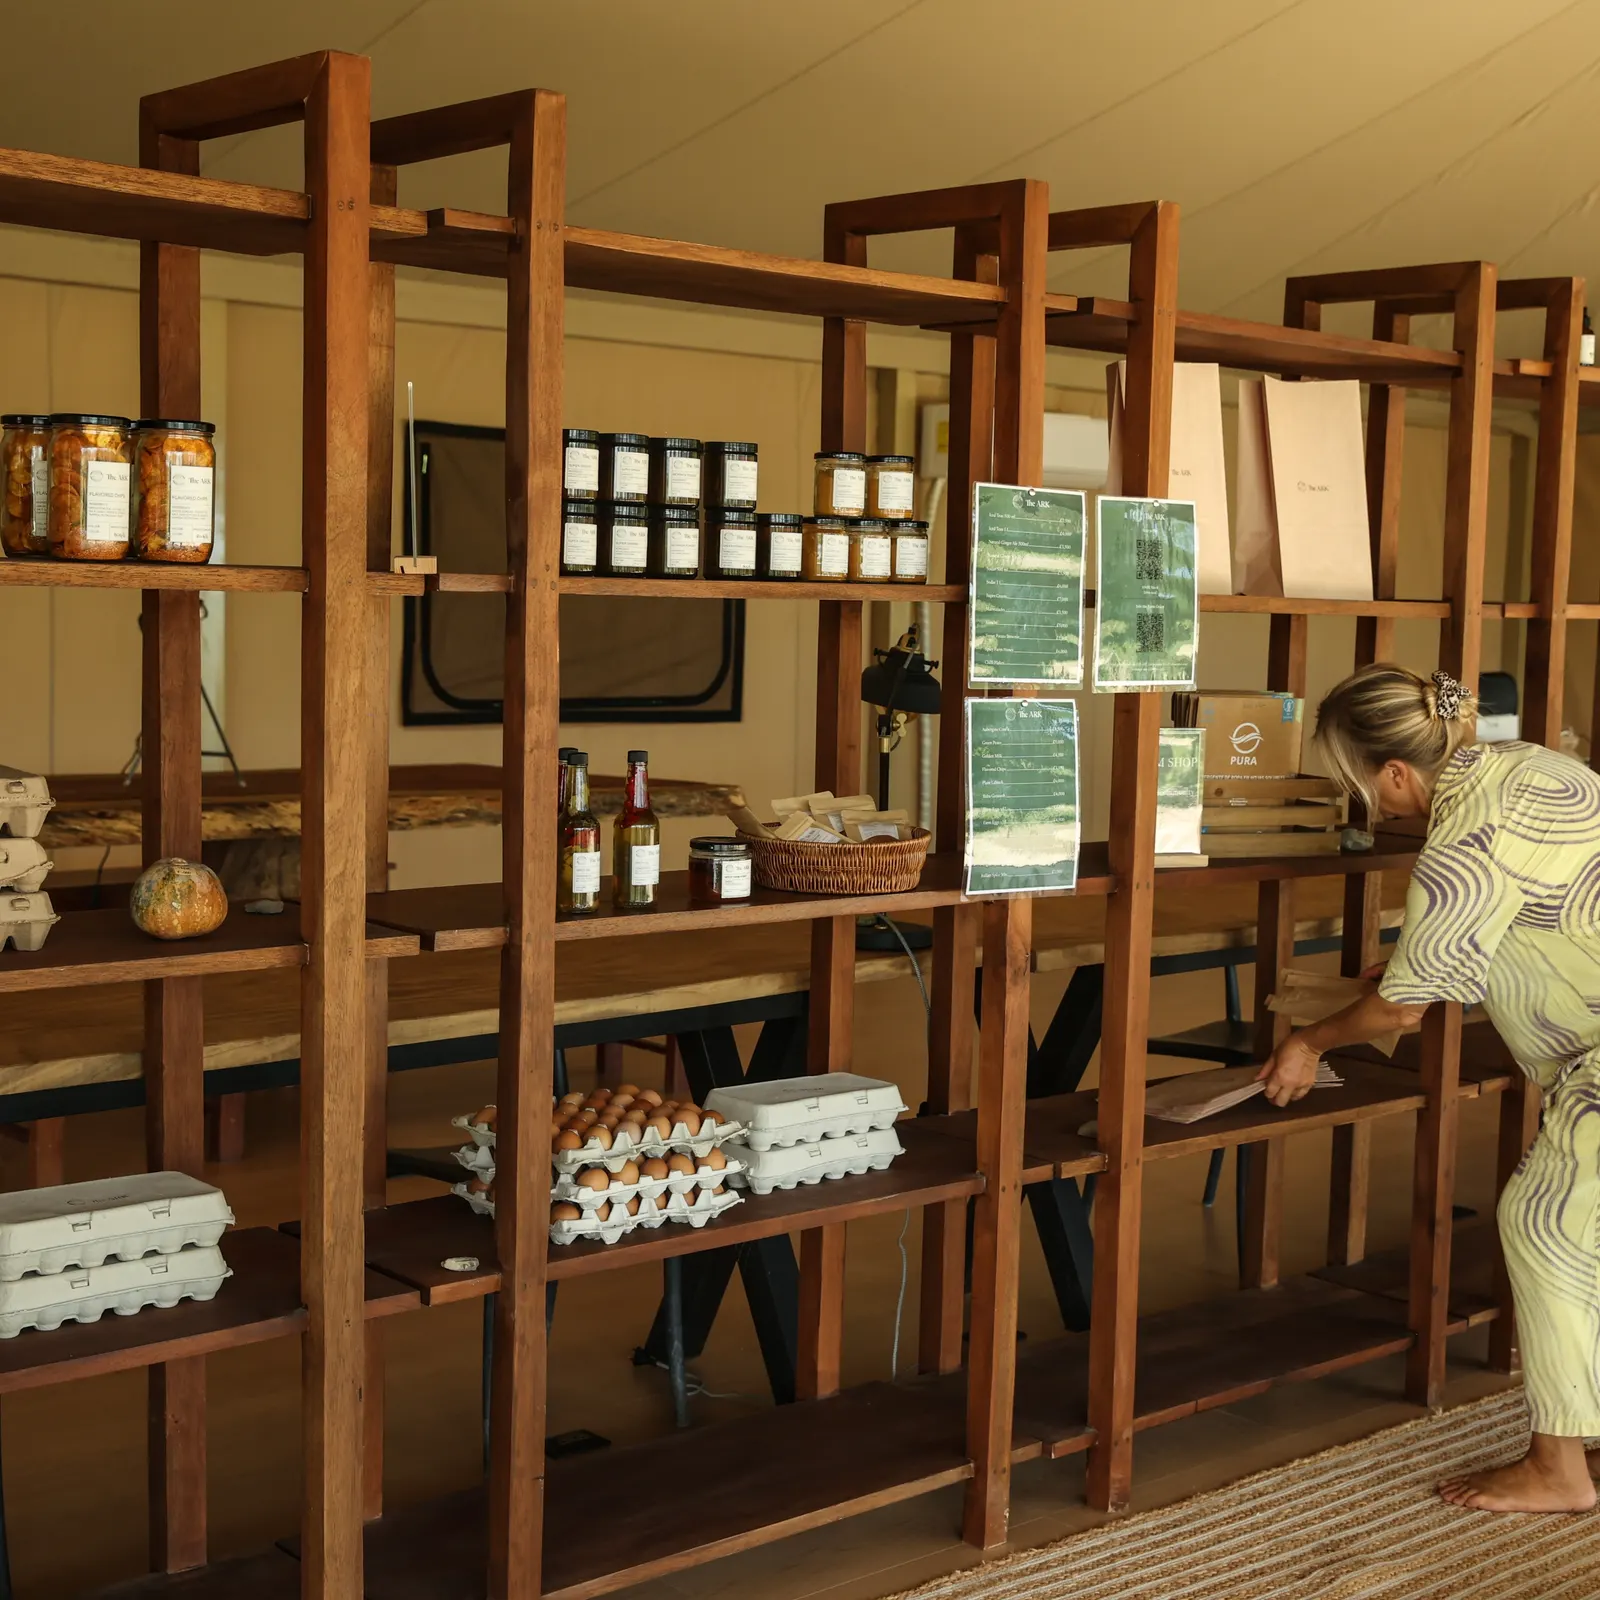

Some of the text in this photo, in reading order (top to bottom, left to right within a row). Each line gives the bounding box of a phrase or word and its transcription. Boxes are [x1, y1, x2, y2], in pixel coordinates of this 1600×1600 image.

[1025, 499, 1051, 509] The ARK
[1018, 710, 1043, 719] The ARK
[1167, 757, 1198, 768] SHOP
[1230, 756, 1257, 766] PURA
